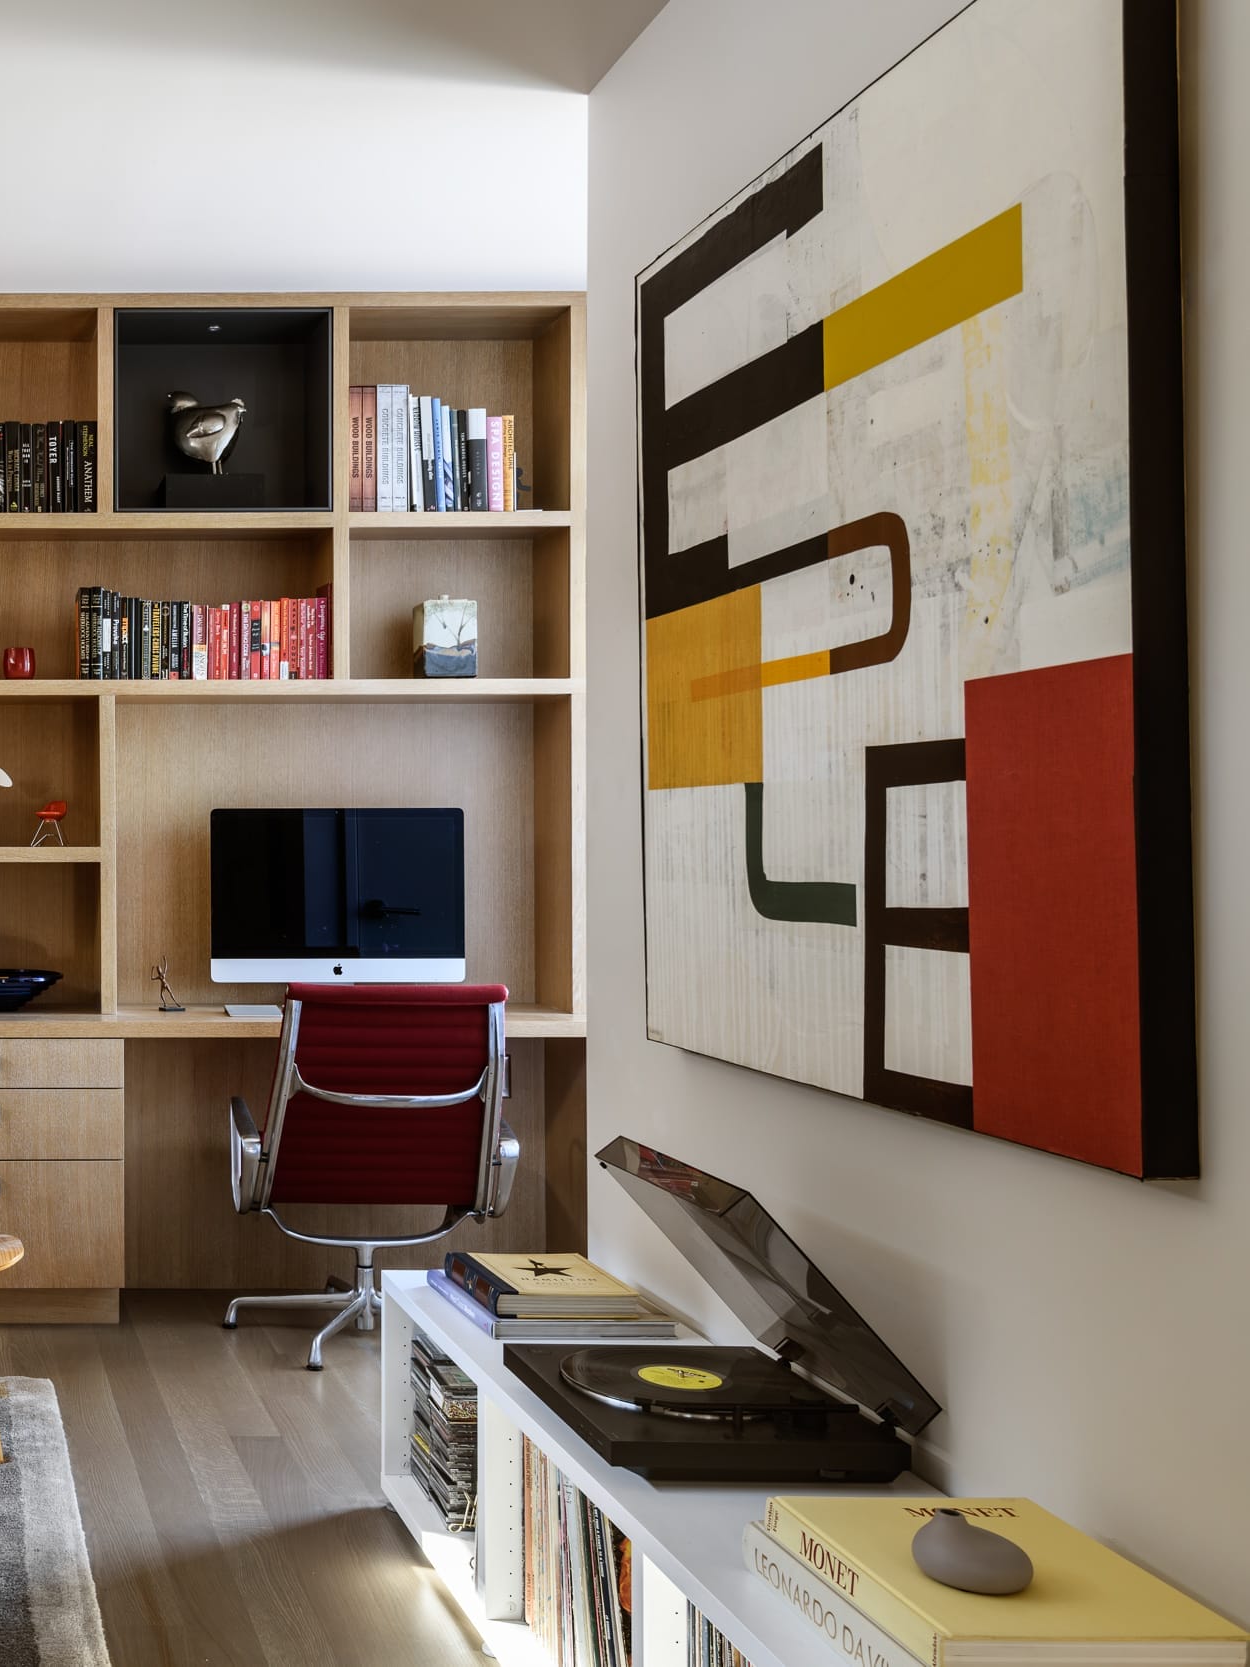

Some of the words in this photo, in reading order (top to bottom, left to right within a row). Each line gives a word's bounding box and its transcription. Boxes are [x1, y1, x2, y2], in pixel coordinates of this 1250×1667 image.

[382, 408, 390, 444] CONCRETE
[396, 408, 404, 444] CONCRETE
[490, 421, 500, 444] SPA
[49, 436, 57, 464] TOYER
[382, 447, 390, 484] BUILDINGS
[396, 446, 404, 484] BUILDINGS
[84, 460, 92, 503] ANATHEM
[492, 452, 502, 502] DESIGN
[152, 608, 160, 636] TRAVELERS
[316, 604, 326, 630] Dangerous
[152, 638, 160, 653] CHRIS
[152, 654, 160, 674] PAVONE
[902, 1507, 1020, 1517] MNET
[799, 1530, 860, 1597] MONET
[754, 1547, 838, 1640] LEONARDO
[842, 1624, 864, 1661] DA
